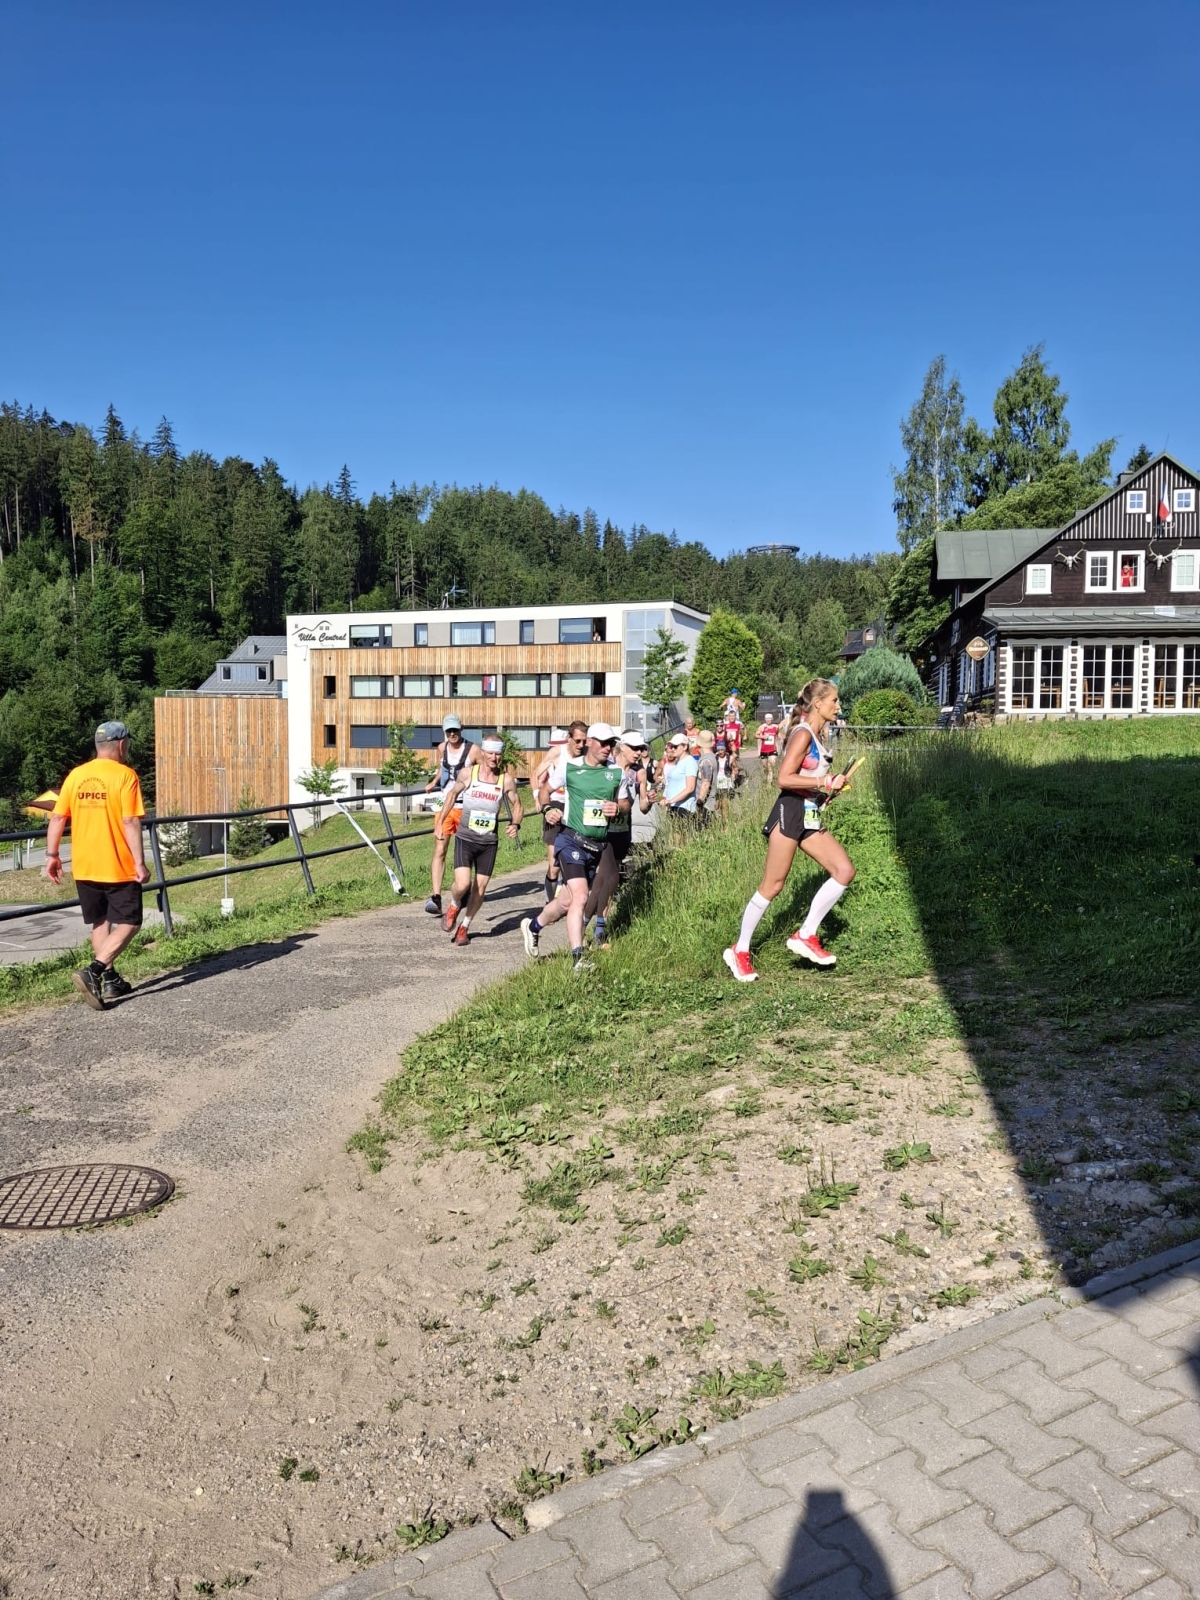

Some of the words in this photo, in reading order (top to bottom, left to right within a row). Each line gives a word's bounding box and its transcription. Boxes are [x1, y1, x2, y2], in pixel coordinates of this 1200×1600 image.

[298, 632, 316, 641] Villa
[319, 632, 347, 642] Central
[471, 790, 499, 801] GERMANY
[475, 819, 490, 827] 422
